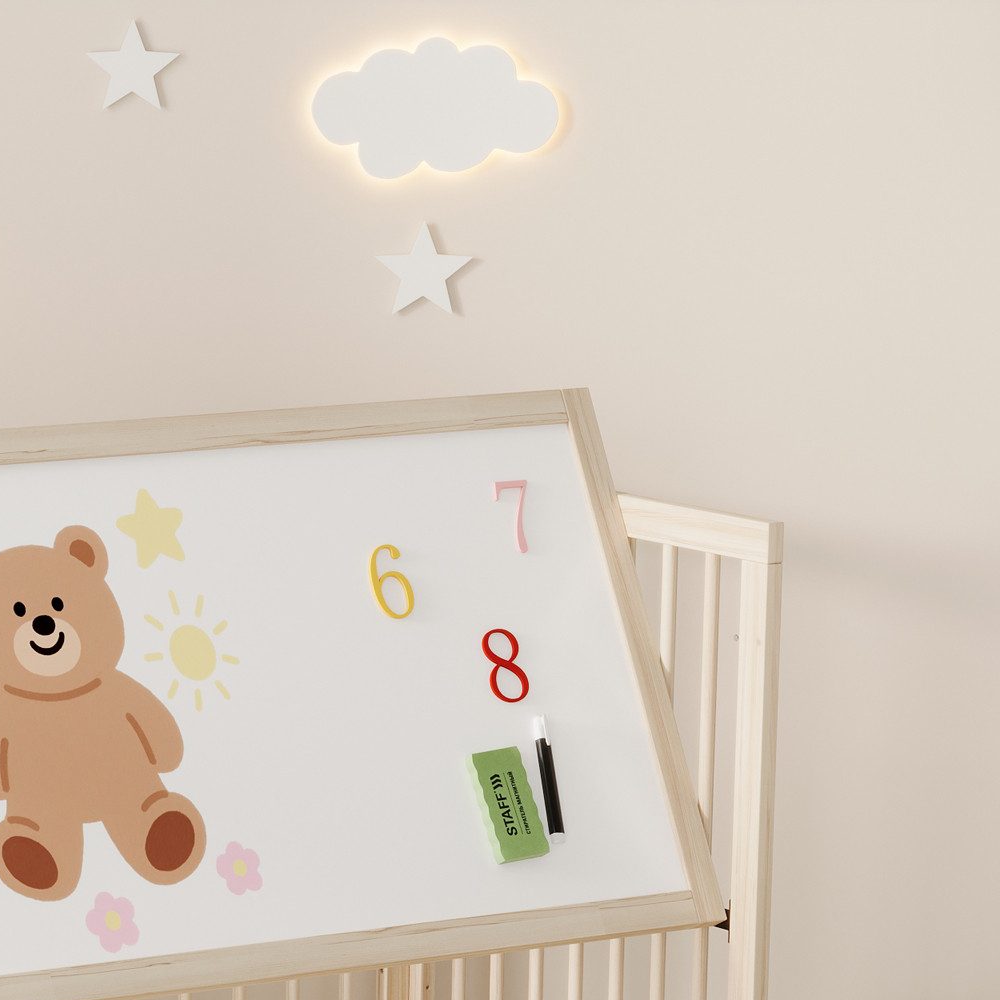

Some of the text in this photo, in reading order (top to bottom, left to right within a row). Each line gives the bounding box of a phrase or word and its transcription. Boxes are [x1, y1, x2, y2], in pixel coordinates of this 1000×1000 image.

[493, 479, 529, 554] 7
[368, 544, 415, 619] 6
[481, 628, 530, 703] 8
[495, 792, 518, 836] STAFF
